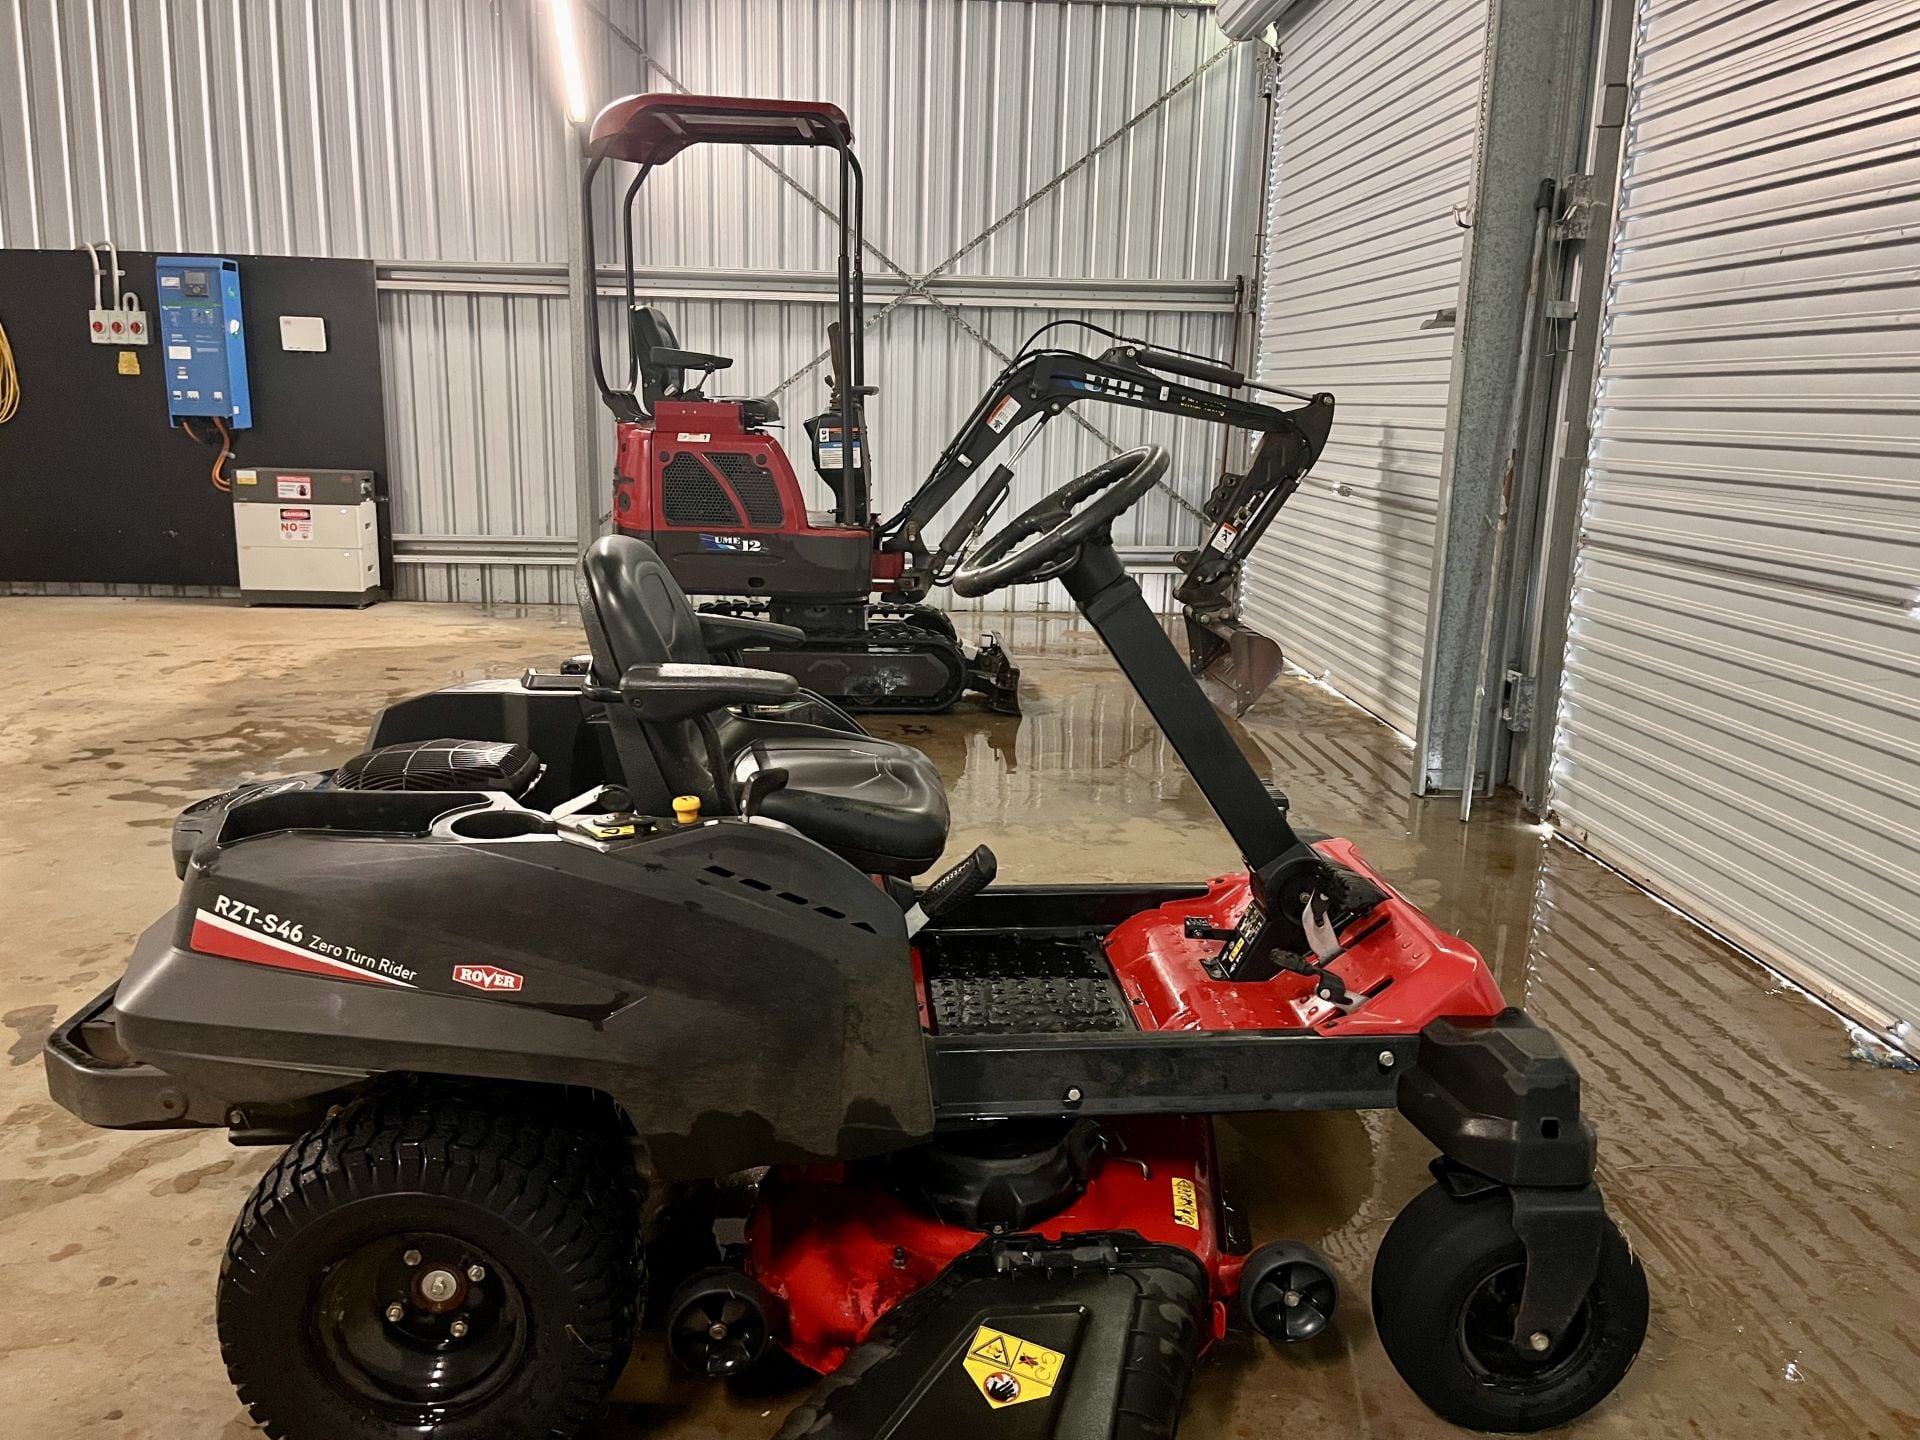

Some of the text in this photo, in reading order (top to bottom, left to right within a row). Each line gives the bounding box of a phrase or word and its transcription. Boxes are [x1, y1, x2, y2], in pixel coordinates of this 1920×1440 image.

[281, 523, 298, 531] NO
[714, 536, 761, 552] UME 12
[214, 894, 418, 981] RZT-S46 Zero Turn Rider
[460, 967, 515, 989] ROVER
